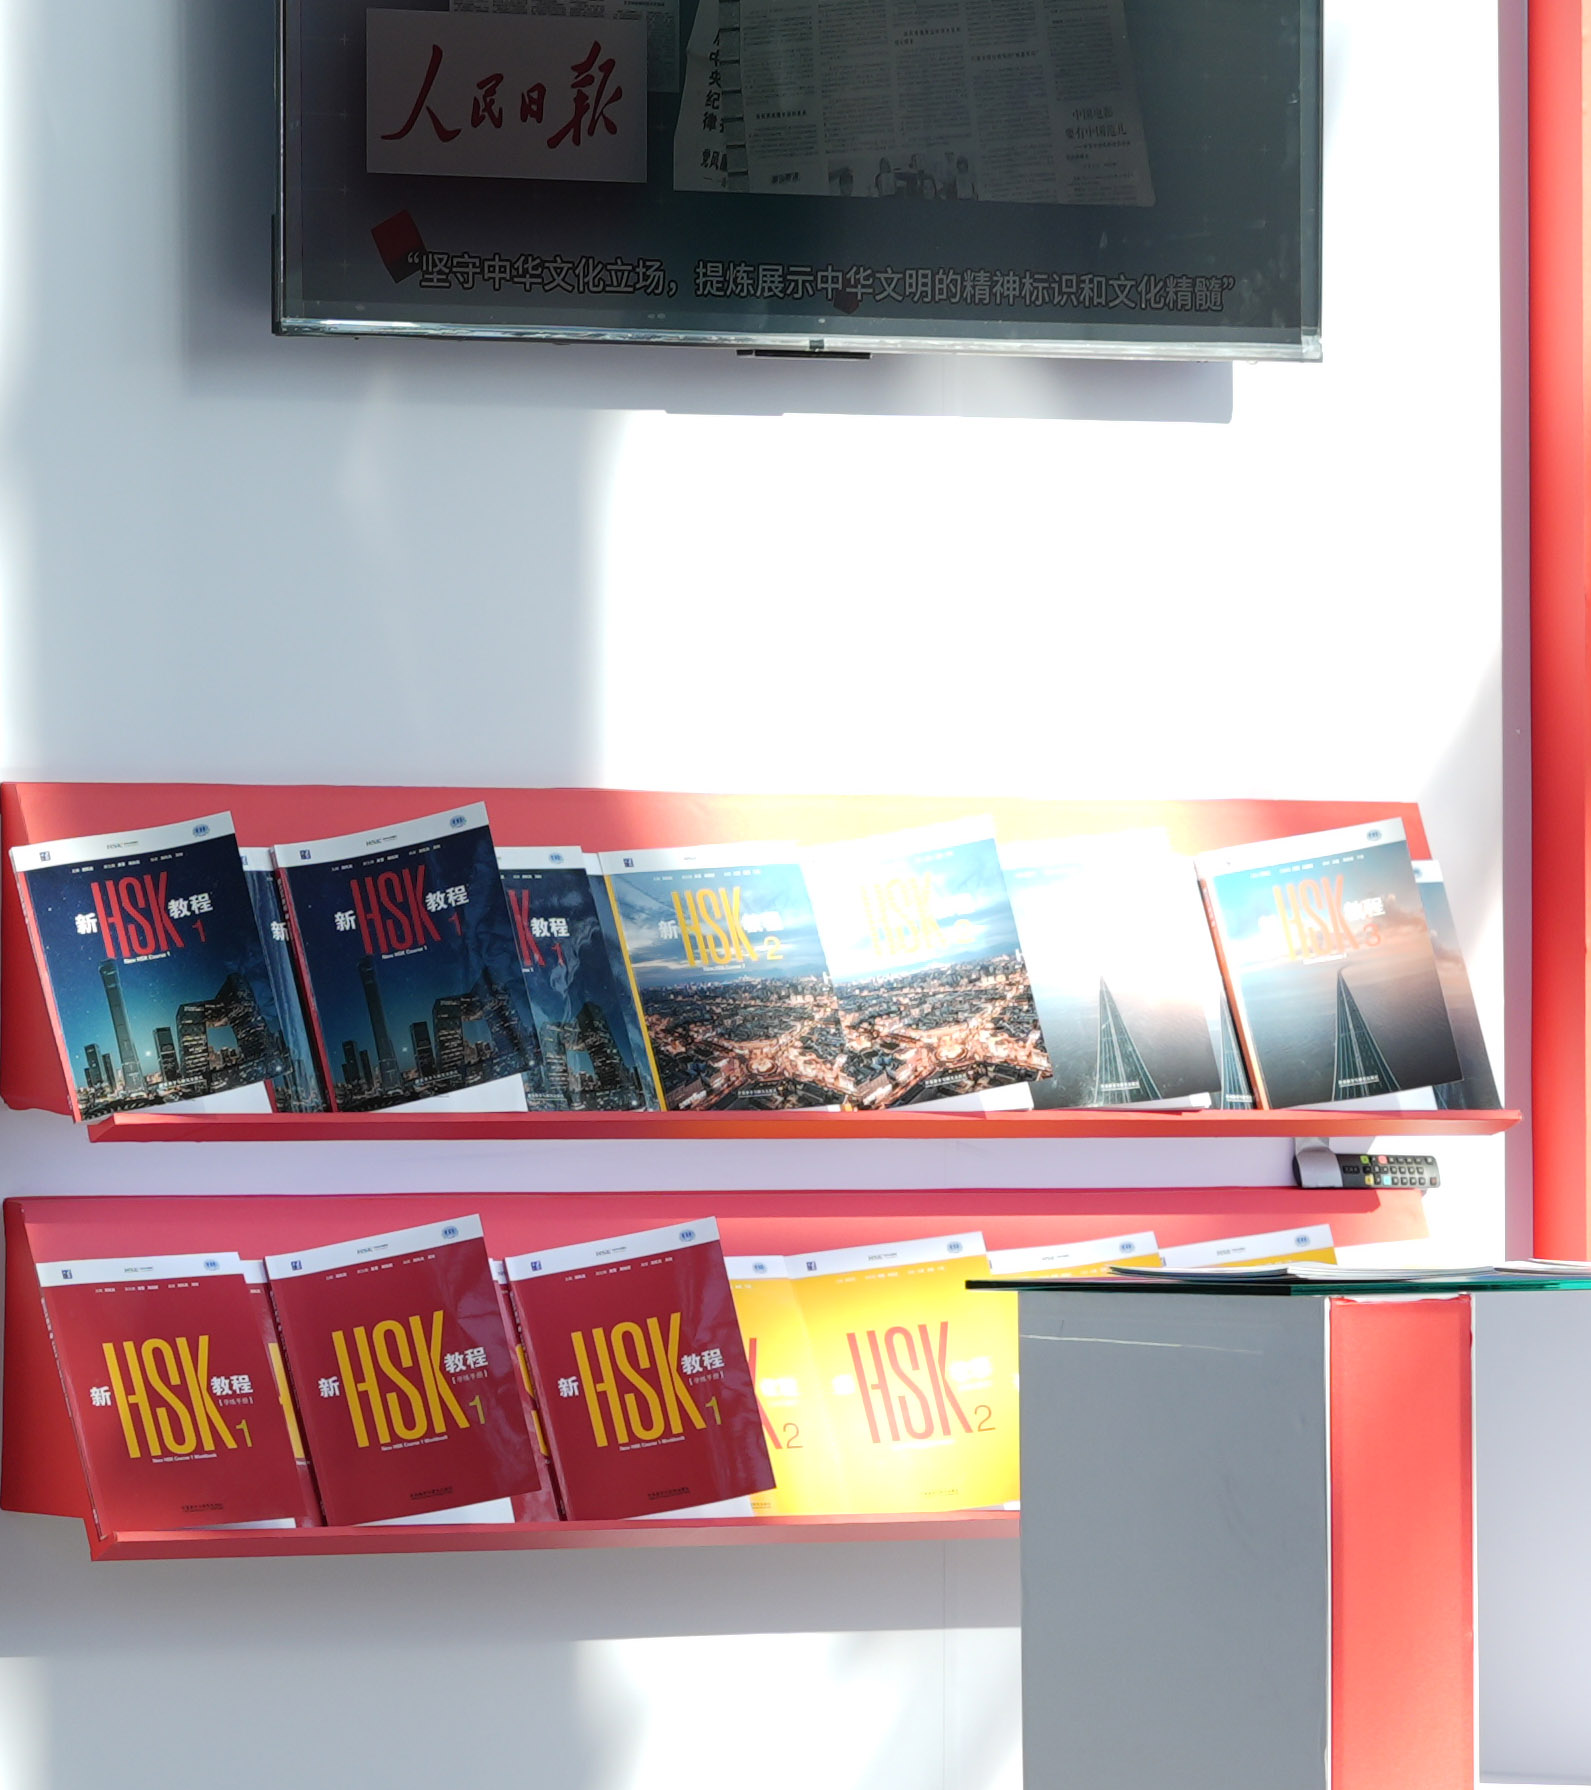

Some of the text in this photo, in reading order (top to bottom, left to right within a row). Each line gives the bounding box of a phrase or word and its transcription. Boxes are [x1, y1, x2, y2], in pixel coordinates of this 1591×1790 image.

[75, 871, 213, 960] 新 HSK 教程
[334, 864, 469, 955] 新 HSK 教程
[449, 912, 462, 936] 1
[192, 920, 206, 943] 1
[530, 917, 570, 937] 教程
[658, 920, 679, 940] 新
[671, 886, 758, 967] HSK
[1362, 922, 1382, 948] 3
[763, 936, 783, 961] 2
[318, 1310, 489, 1448] 新 HSK 教程
[558, 1312, 725, 1447] 新 HSK 教程
[846, 1321, 973, 1443] HSK
[90, 1335, 254, 1459] 新 HSK 教程
[469, 1395, 486, 1424] 1
[705, 1396, 722, 1425] 1
[974, 1404, 997, 1432] 2
[235, 1419, 253, 1447] 1
